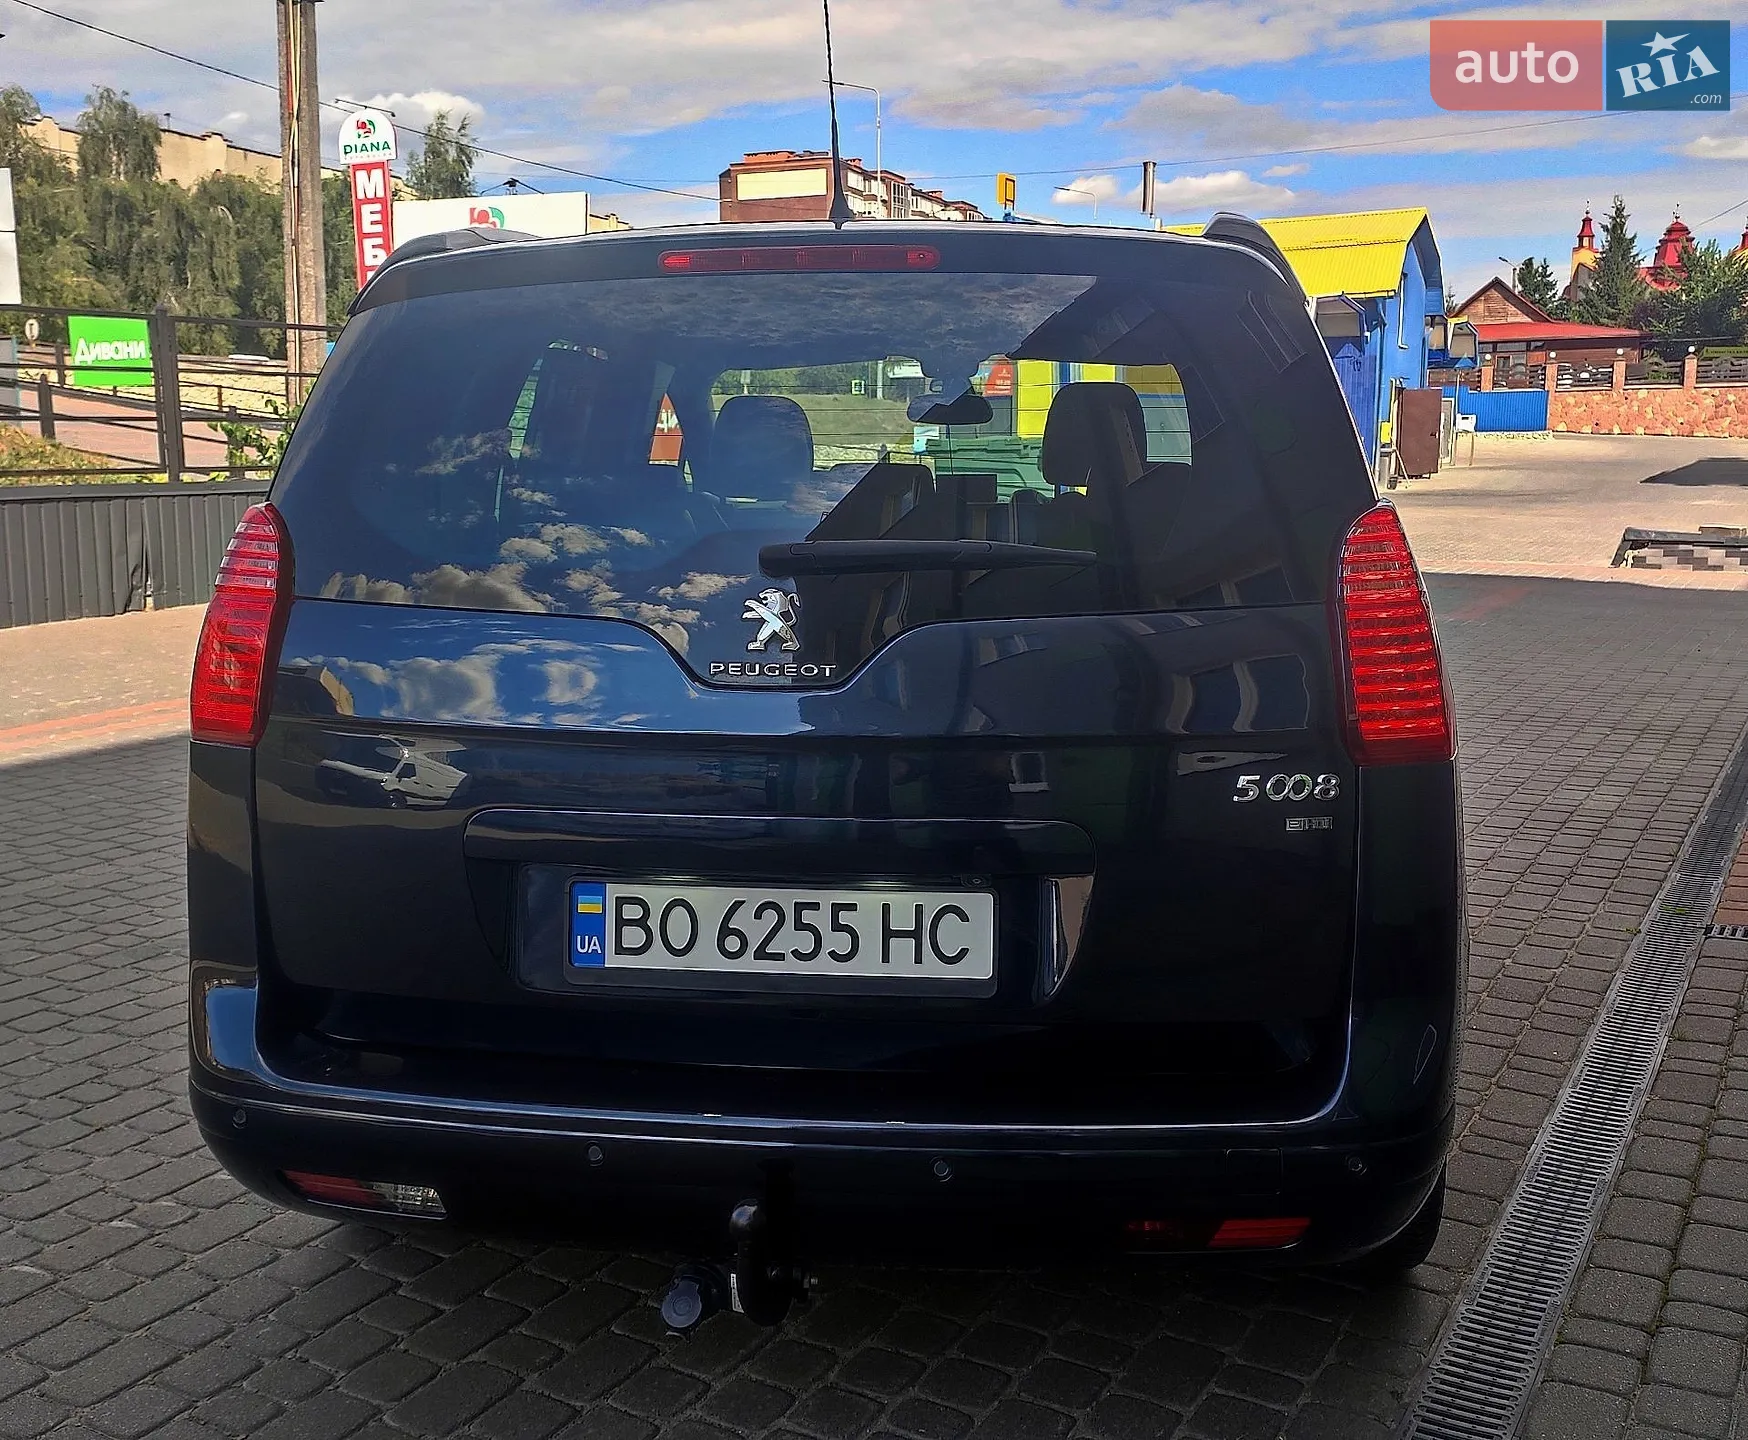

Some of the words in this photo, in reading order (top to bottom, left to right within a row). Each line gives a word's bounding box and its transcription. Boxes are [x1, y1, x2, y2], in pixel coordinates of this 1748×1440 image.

[343, 140, 391, 155] DIANA
[354, 168, 388, 280] МЕБ
[74, 337, 147, 366] Дивани
[710, 662, 837, 677] PEUGEOT
[1233, 773, 1340, 802] 5008
[577, 935, 601, 954] UA
[613, 895, 698, 957] BO
[716, 899, 860, 963] 6255
[881, 902, 970, 966] HC
